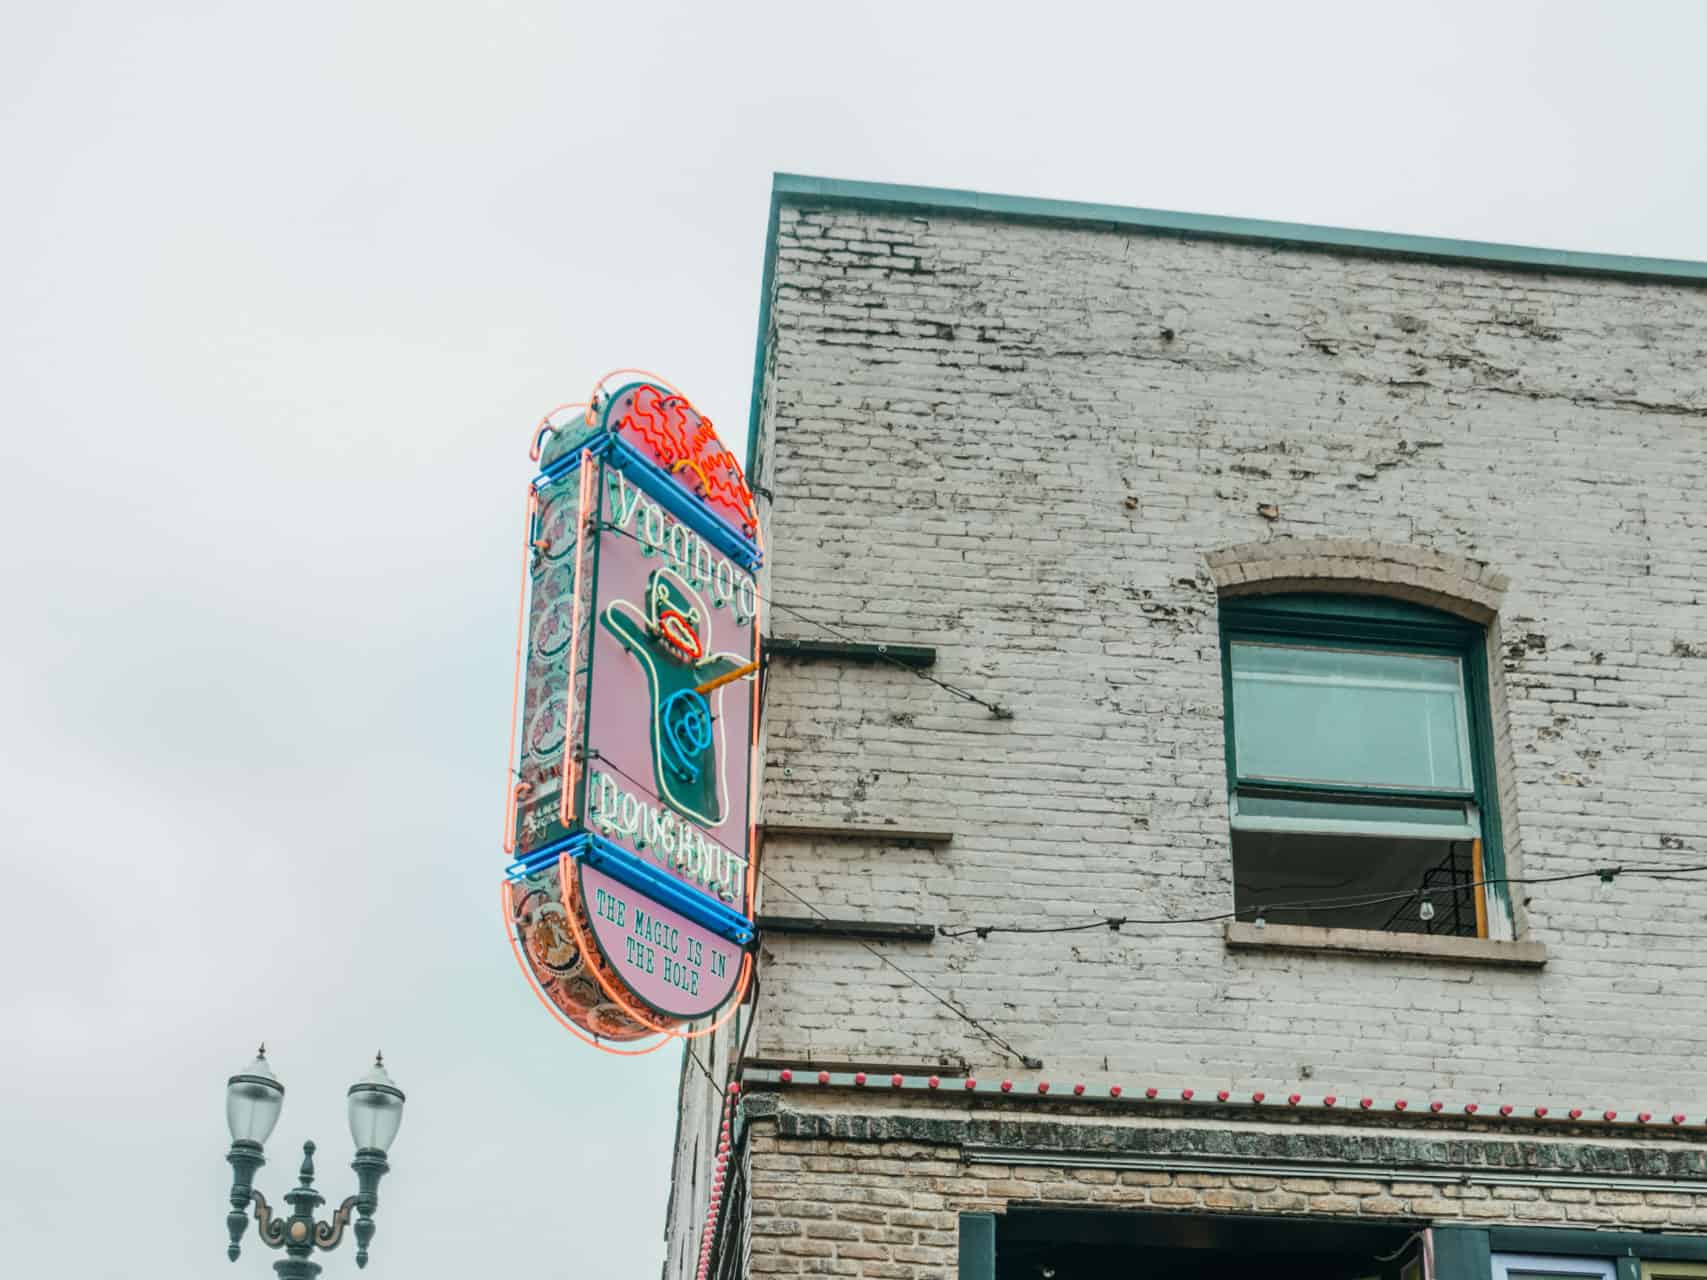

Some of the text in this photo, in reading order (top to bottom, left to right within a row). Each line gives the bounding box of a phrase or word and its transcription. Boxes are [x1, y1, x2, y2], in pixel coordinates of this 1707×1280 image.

[606, 470, 757, 626] VOODOO
[590, 770, 748, 900] DOUGHNUT
[596, 888, 727, 979] THE MAGIC IS IN
[626, 935, 700, 997] THE HOLE
